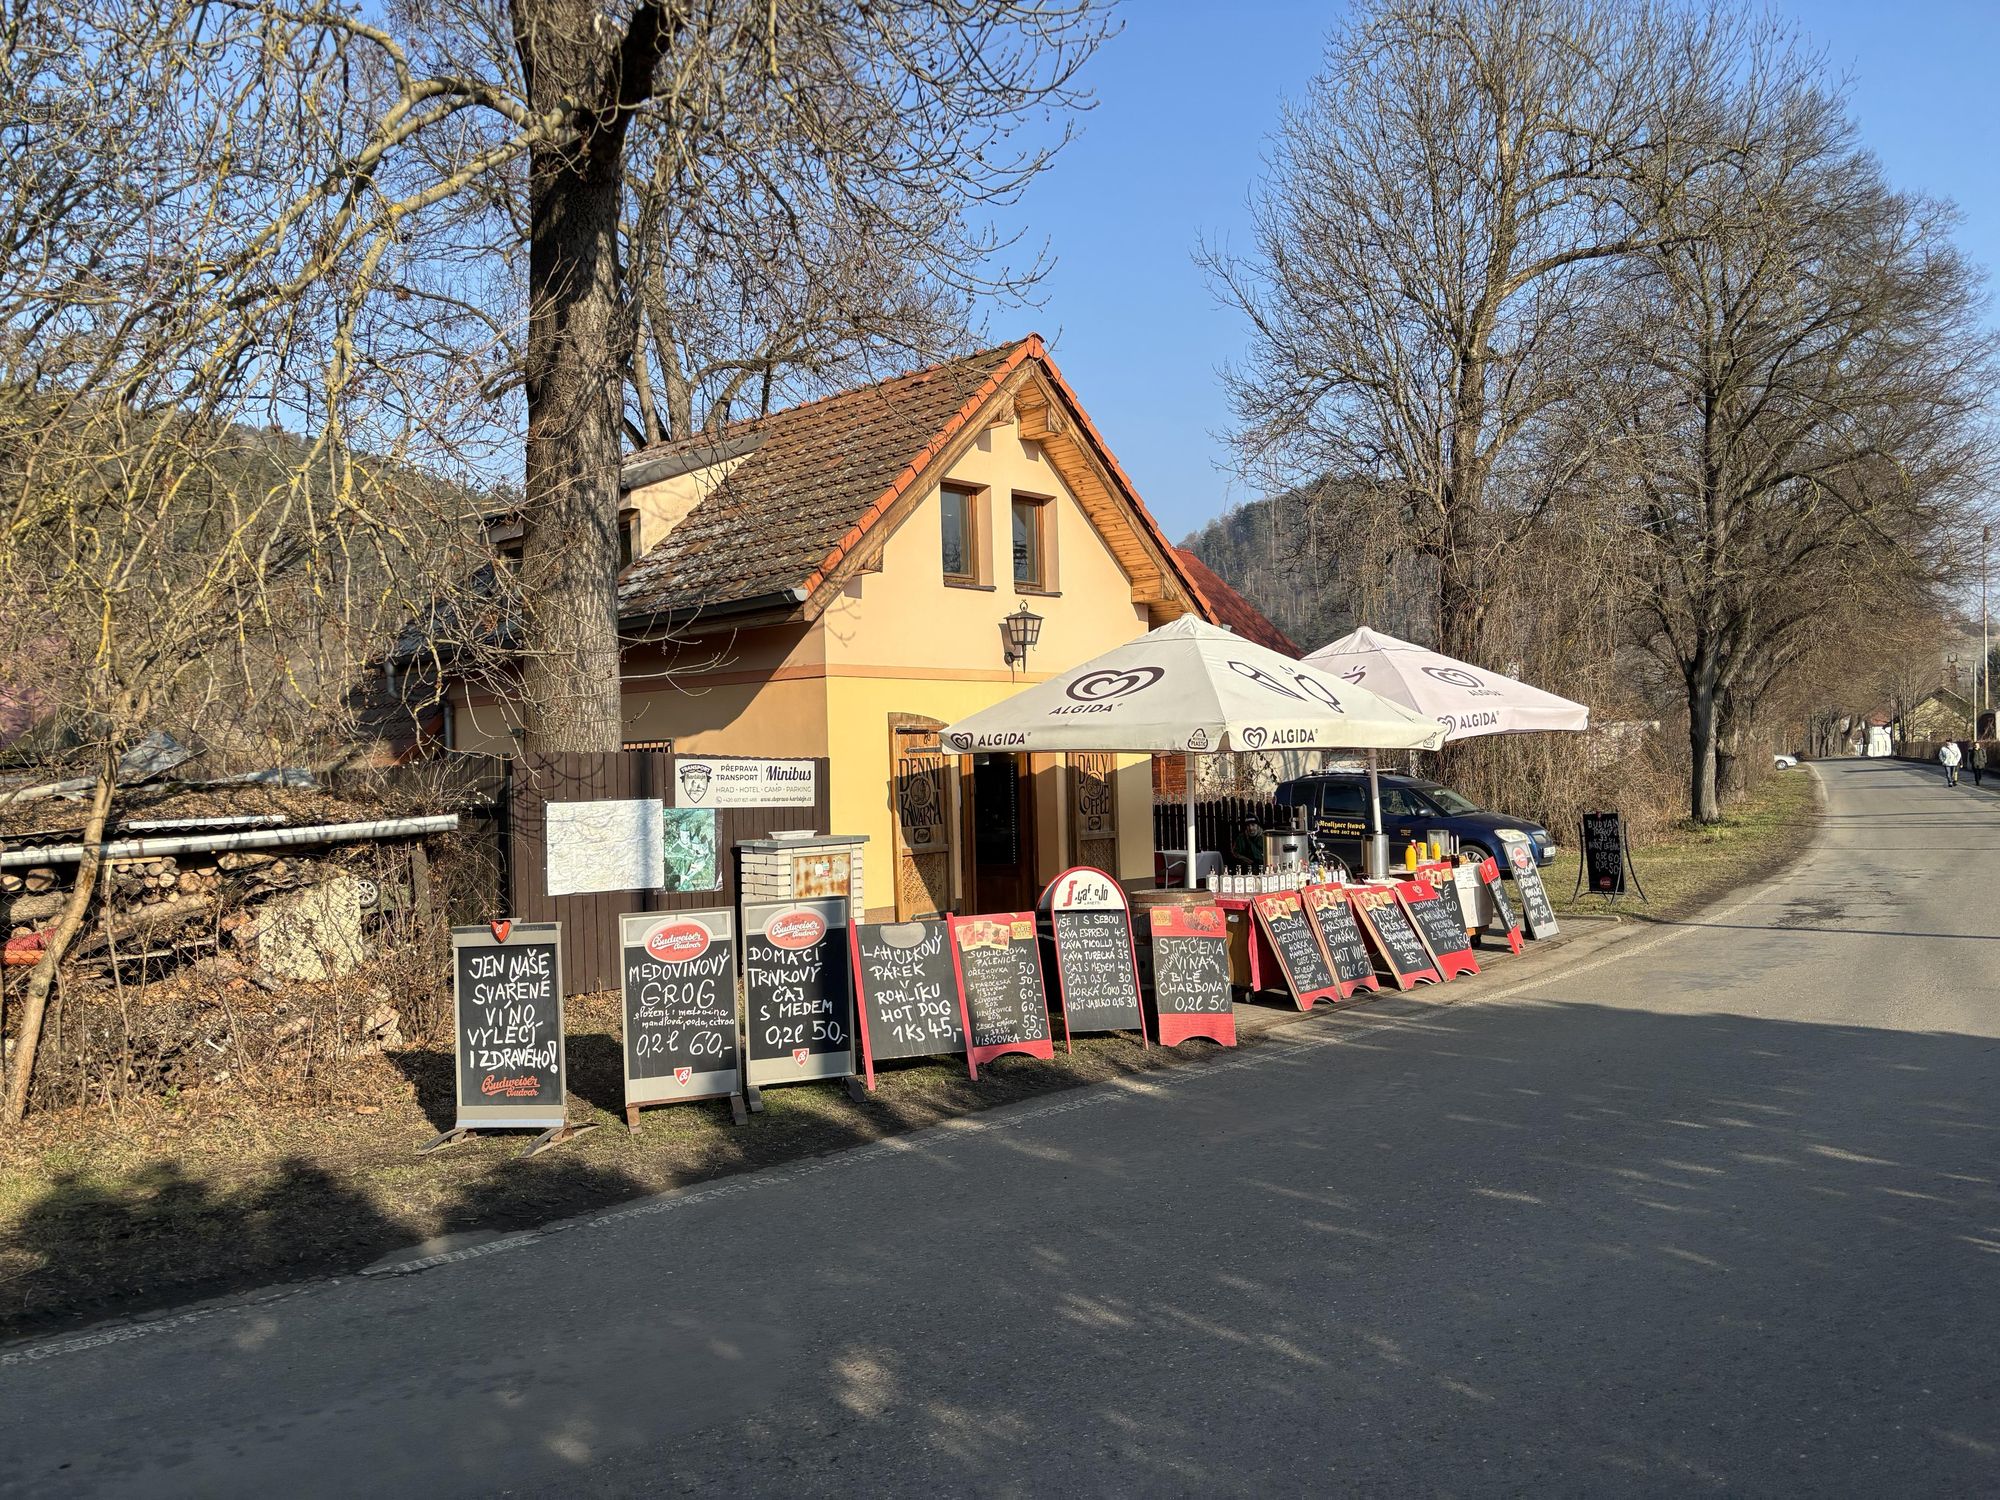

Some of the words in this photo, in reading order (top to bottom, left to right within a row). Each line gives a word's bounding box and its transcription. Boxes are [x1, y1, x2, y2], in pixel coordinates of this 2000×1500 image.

[1049, 704, 1113, 715] ALGIDA
[1460, 712, 1497, 729] ALGIDA
[978, 733, 1025, 746] ALGIDA
[1272, 728, 1315, 743] ALGIDA
[721, 764, 758, 772] PŘEPRAVA
[766, 766, 811, 781] Minibus
[898, 757, 940, 793] DENNÍ
[1079, 754, 1108, 784] DAILY
[1080, 785, 1109, 815] COFFEE
[772, 922, 820, 935] Budweiser
[1056, 915, 1071, 928] VŠE
[1083, 916, 1089, 924] S
[1094, 915, 1118, 924] SEBOU
[652, 933, 703, 948] Budweiser
[1059, 928, 1078, 939] KÁVA
[1080, 929, 1109, 937] ESPRESO
[1115, 928, 1125, 937] 45
[674, 942, 701, 950] Budvar
[862, 926, 942, 964] LAHŮDKOVÝ
[1061, 940, 1081, 950] KÁVA
[1116, 939, 1127, 947] 40
[1159, 937, 1227, 955] STÁČENÁ
[748, 943, 827, 965] DOMÁCÍ
[1063, 951, 1082, 962] KÁVA
[1084, 948, 1115, 960] TURECKÁ
[1118, 950, 1128, 959] 35
[1175, 954, 1208, 970] VÍNA
[1332, 947, 1350, 963] HOT
[469, 954, 504, 979] JEN
[509, 949, 550, 980] NAŠE
[629, 948, 729, 983] MEDOVINOVÝ
[869, 961, 925, 980] PÁREK
[1018, 962, 1034, 975] 50
[1065, 962, 1082, 975] ČAJ
[1084, 963, 1089, 971] S
[1092, 963, 1115, 973] MEDEM
[1118, 962, 1130, 971] 40
[1067, 973, 1086, 986] ČAJ
[1119, 974, 1130, 982] 30
[1171, 970, 1201, 982] BÍLÉ
[473, 972, 550, 1004] SVAŘENÉ
[641, 979, 715, 1008] GROG
[772, 986, 804, 1002] ČAJ
[874, 982, 940, 1004] ROHLÍKU
[1069, 984, 1099, 996] HORKÁ
[1122, 984, 1133, 995] 50
[1126, 997, 1137, 1007] 30
[485, 1000, 535, 1028] VÍNO
[760, 1005, 771, 1021] S
[779, 1000, 833, 1018] MEDEM
[881, 1005, 912, 1022] HOT
[918, 1000, 951, 1017] DOG
[928, 1017, 962, 1042] 45,-
[1024, 1028, 1042, 1039] 50
[690, 1031, 732, 1058] 60,-
[479, 1041, 558, 1074] ZDRAVÉHO!
[481, 1074, 540, 1092] Budweiser
[506, 1087, 539, 1096] Budvar
